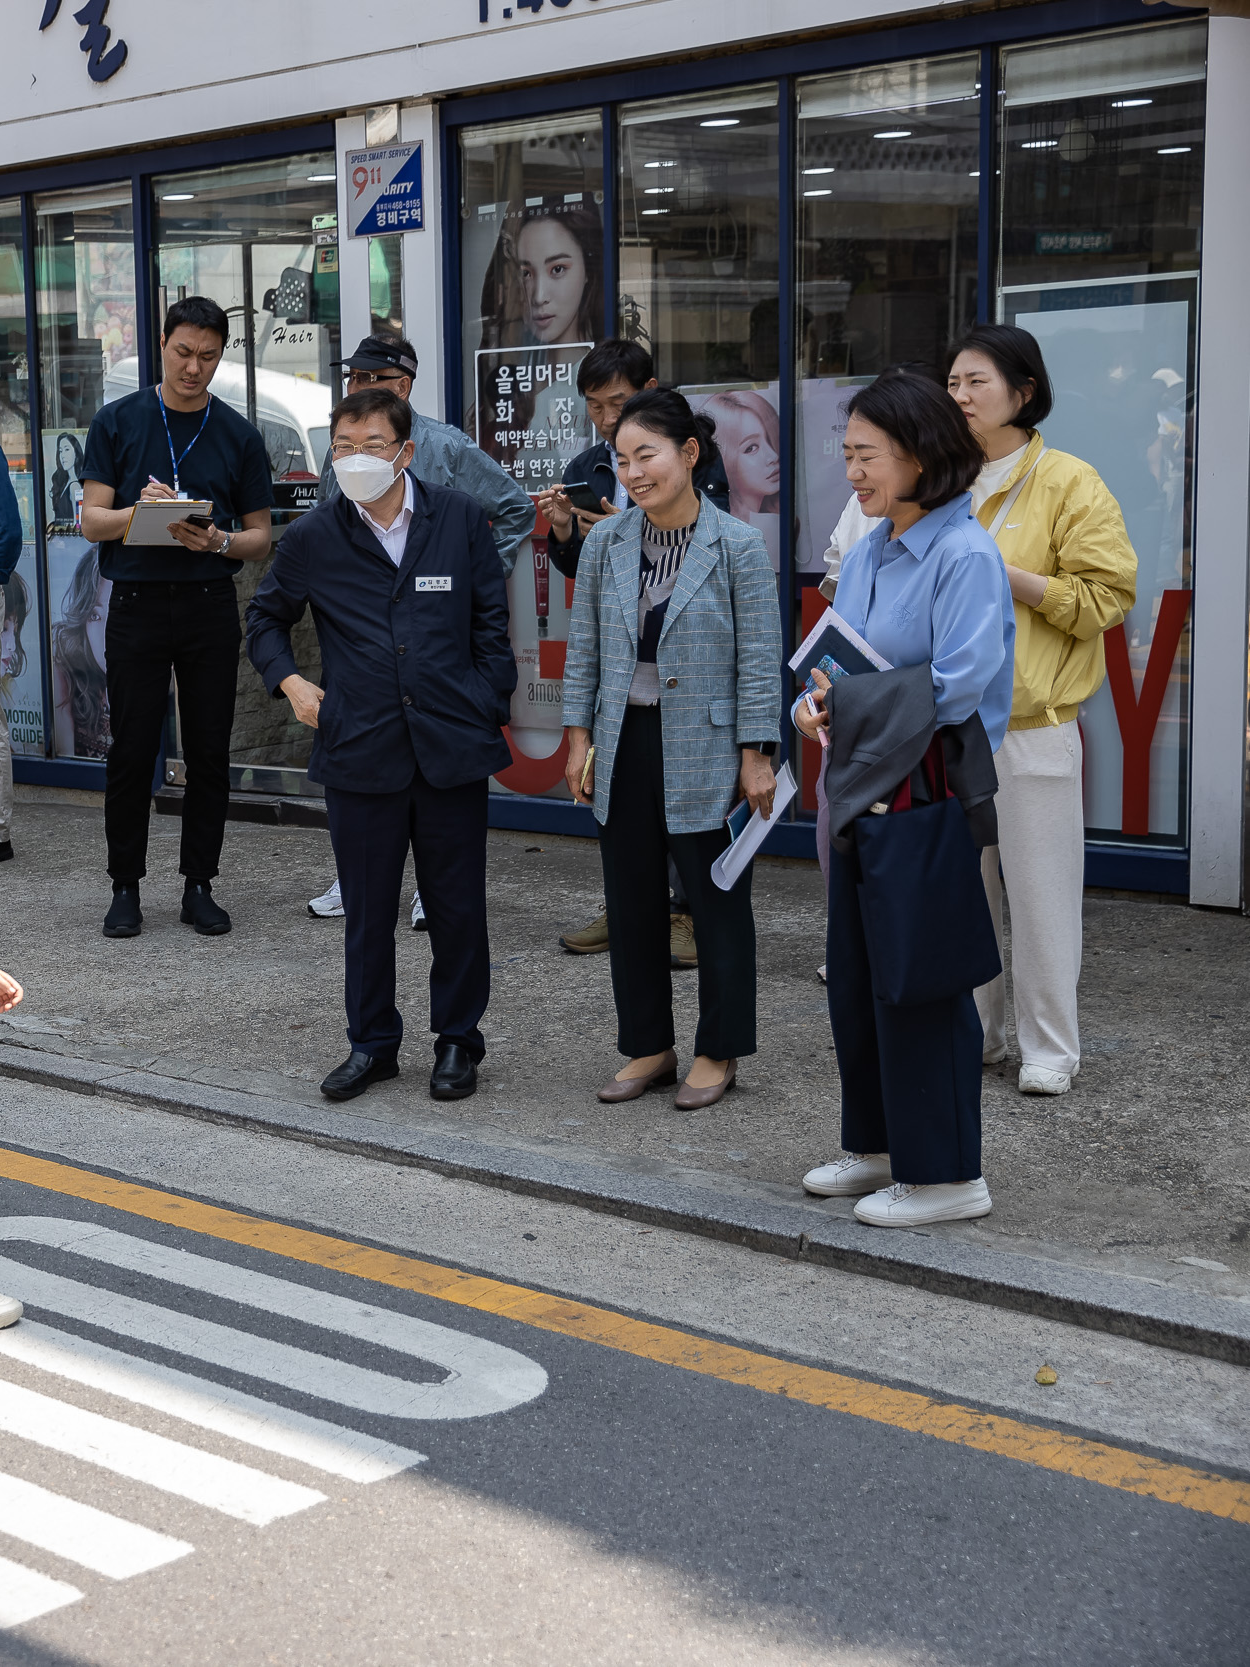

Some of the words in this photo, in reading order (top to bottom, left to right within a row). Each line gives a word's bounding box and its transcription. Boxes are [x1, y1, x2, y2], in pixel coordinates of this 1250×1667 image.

[352, 166, 381, 201] 911
[376, 208, 422, 228] 경비구역
[272, 326, 314, 345] Hair
[495, 362, 573, 394] 올림머리
[495, 399, 515, 425] 화
[555, 397, 575, 425] 장
[495, 427, 576, 449] 예약받습니다
[529, 458, 556, 478] 연장
[527, 682, 562, 703] amos
[12, 727, 44, 745] GUIDE
